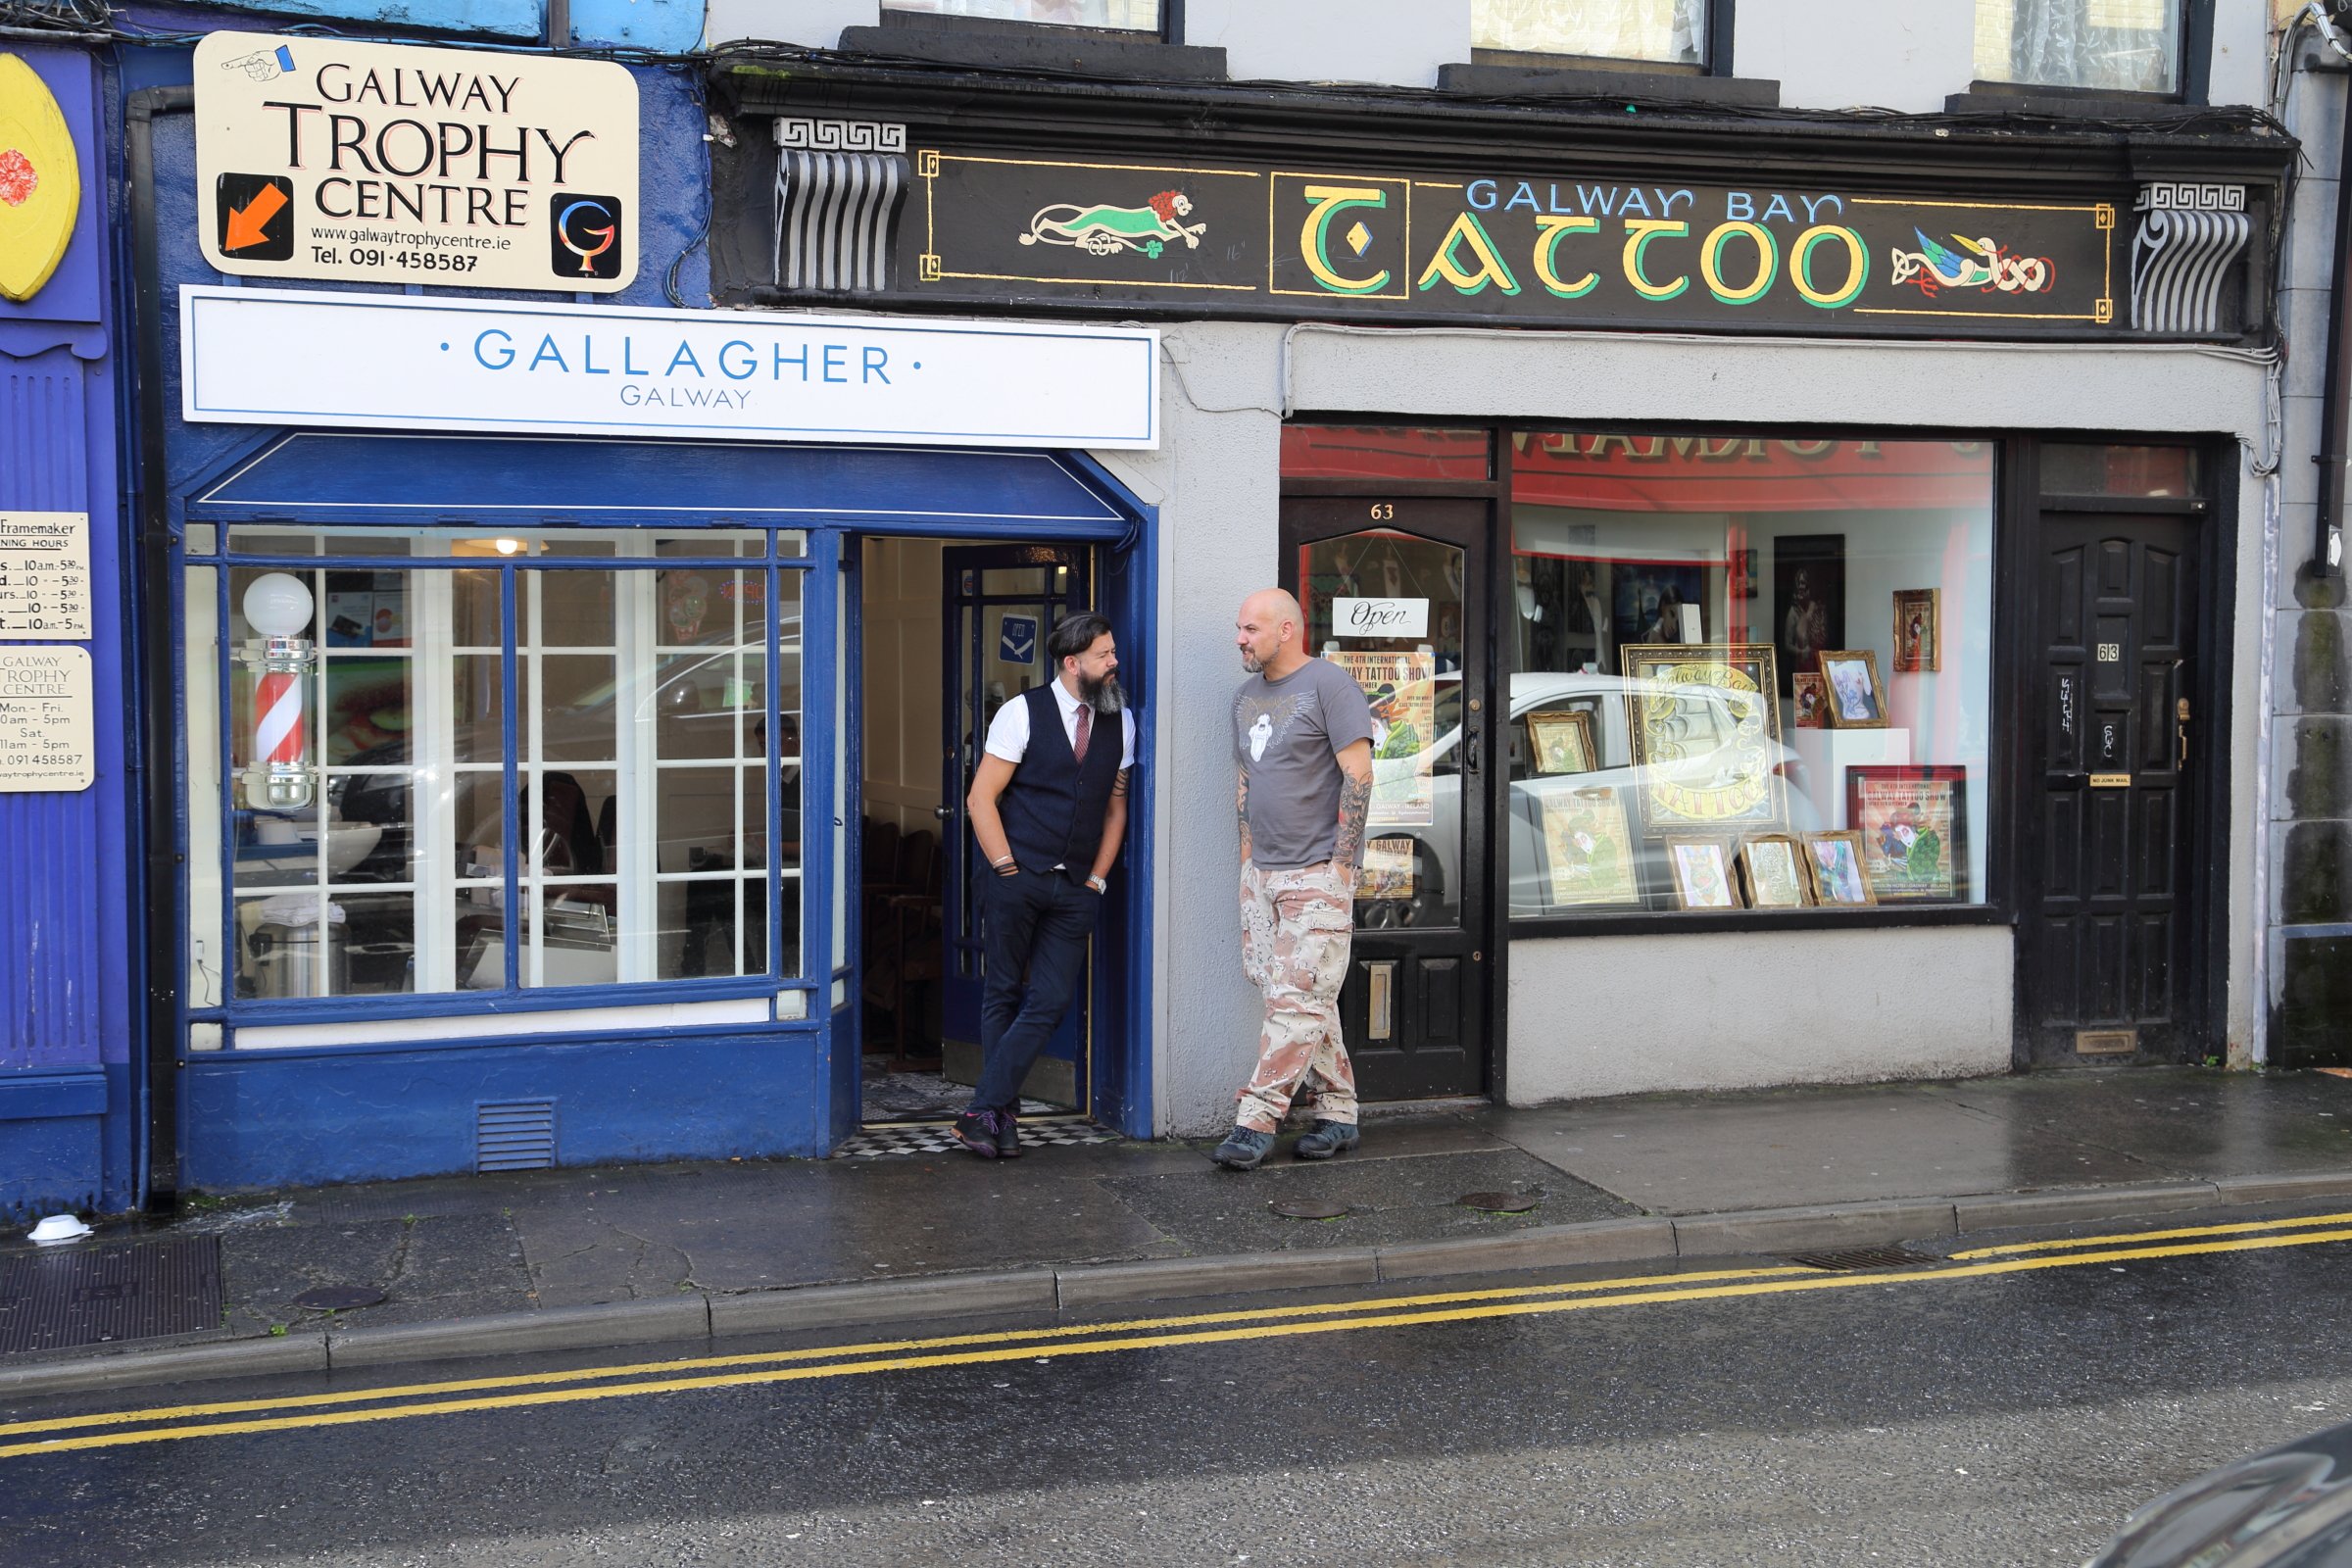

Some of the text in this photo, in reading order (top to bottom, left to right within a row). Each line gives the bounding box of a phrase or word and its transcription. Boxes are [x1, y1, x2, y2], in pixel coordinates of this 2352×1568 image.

[316, 63, 524, 114] GALWAY
[263, 101, 597, 185] TROPHY
[315, 176, 531, 228] CENTRE
[1466, 178, 1844, 224] GALWAY BAY
[311, 226, 511, 251] www.galwaytrophycentre.ie
[1300, 185, 1869, 310] TATTOO
[311, 246, 342, 265] Tel.
[474, 328, 892, 385] GALLAGHER
[620, 384, 751, 410] GALWAY
[1370, 504, 1394, 519] 63
[0, 519, 75, 534] Framemaker
[1350, 601, 1411, 635] Open
[1367, 656, 1411, 664] INTERNATIAL
[2099, 645, 2119, 661] 63
[3, 656, 62, 667] GALWAY
[0, 668, 72, 683] ROPHY
[1365, 666, 1400, 681] TATTOO
[3, 683, 66, 695] CENTRE
[42, 702, 64, 712] Fri.
[43, 713, 71, 725] 5pm
[20, 727, 45, 738] Sat.
[42, 738, 70, 751] 5pm
[7, 755, 28, 765] 091
[31, 754, 82, 765] 458587
[1376, 840, 1410, 850] GALWAY
